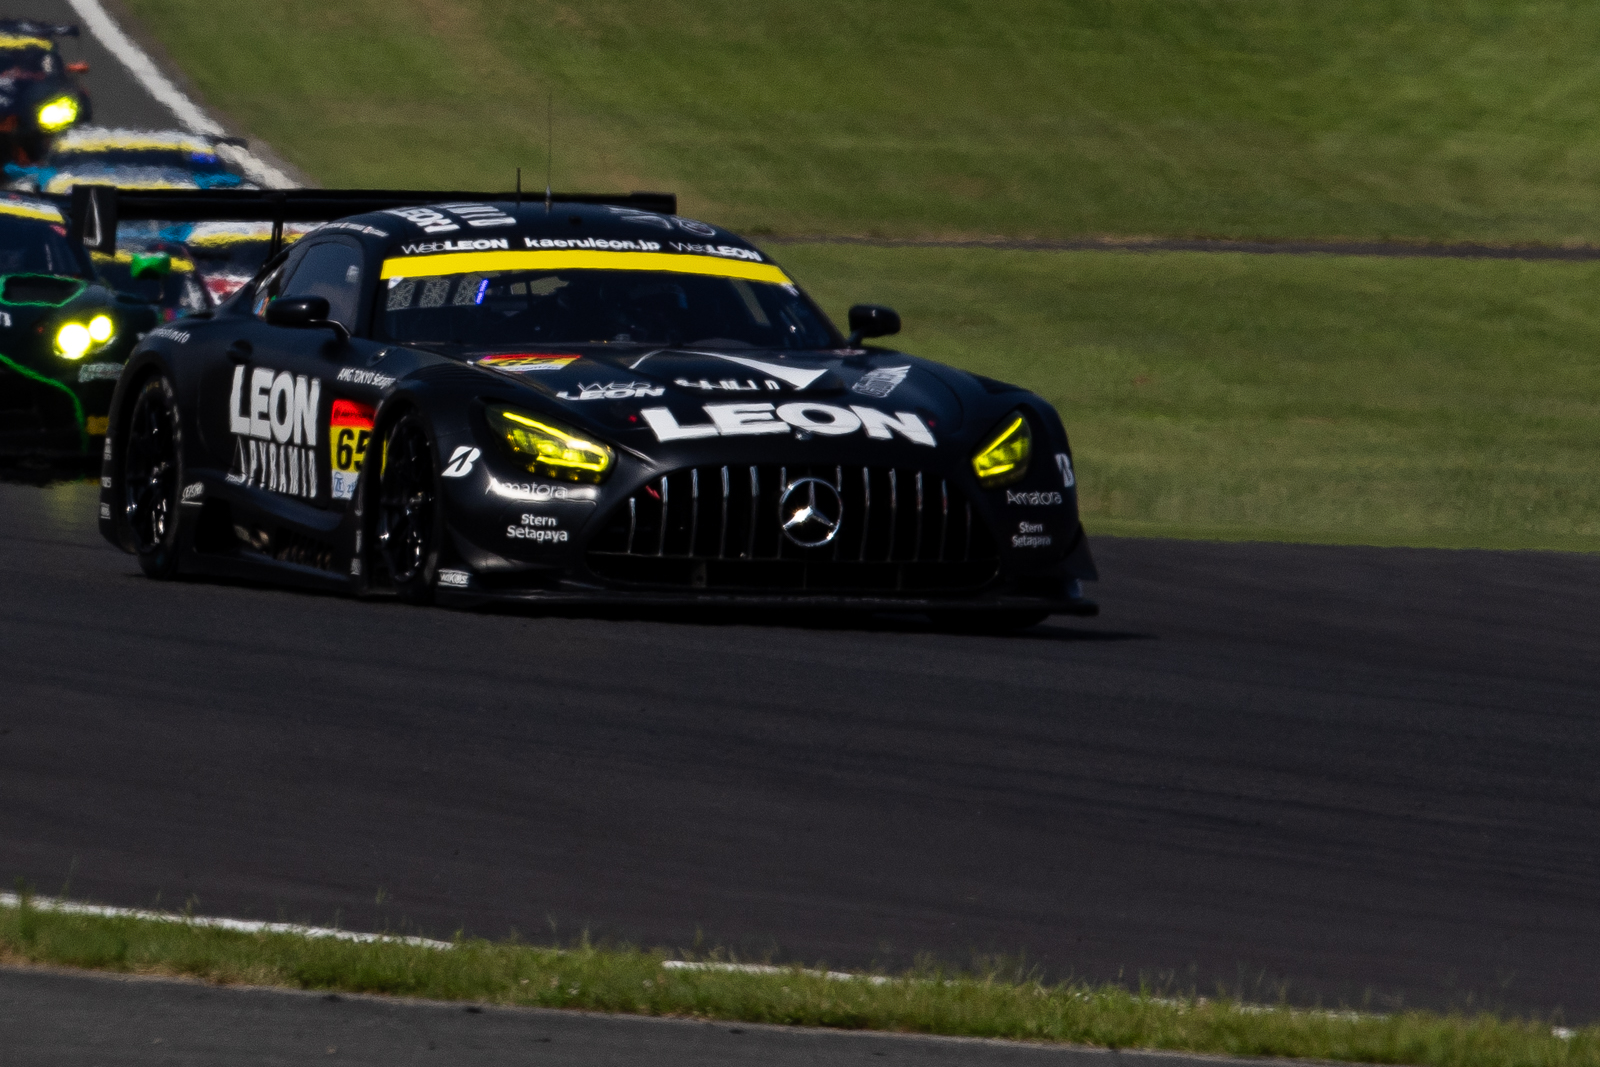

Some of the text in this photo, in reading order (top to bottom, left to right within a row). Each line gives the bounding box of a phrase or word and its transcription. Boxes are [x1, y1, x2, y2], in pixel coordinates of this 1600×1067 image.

[401, 237, 510, 255] WebLEON
[523, 236, 662, 251] kaeruleon.jp
[556, 388, 666, 401] LEON
[230, 364, 321, 447] LEON
[640, 402, 937, 448] LEON
[337, 428, 372, 471] 65
[1006, 489, 1063, 505] Amatora
[521, 513, 557, 528] Stern
[1019, 521, 1043, 534] Stern
[506, 525, 569, 543] Setagaya
